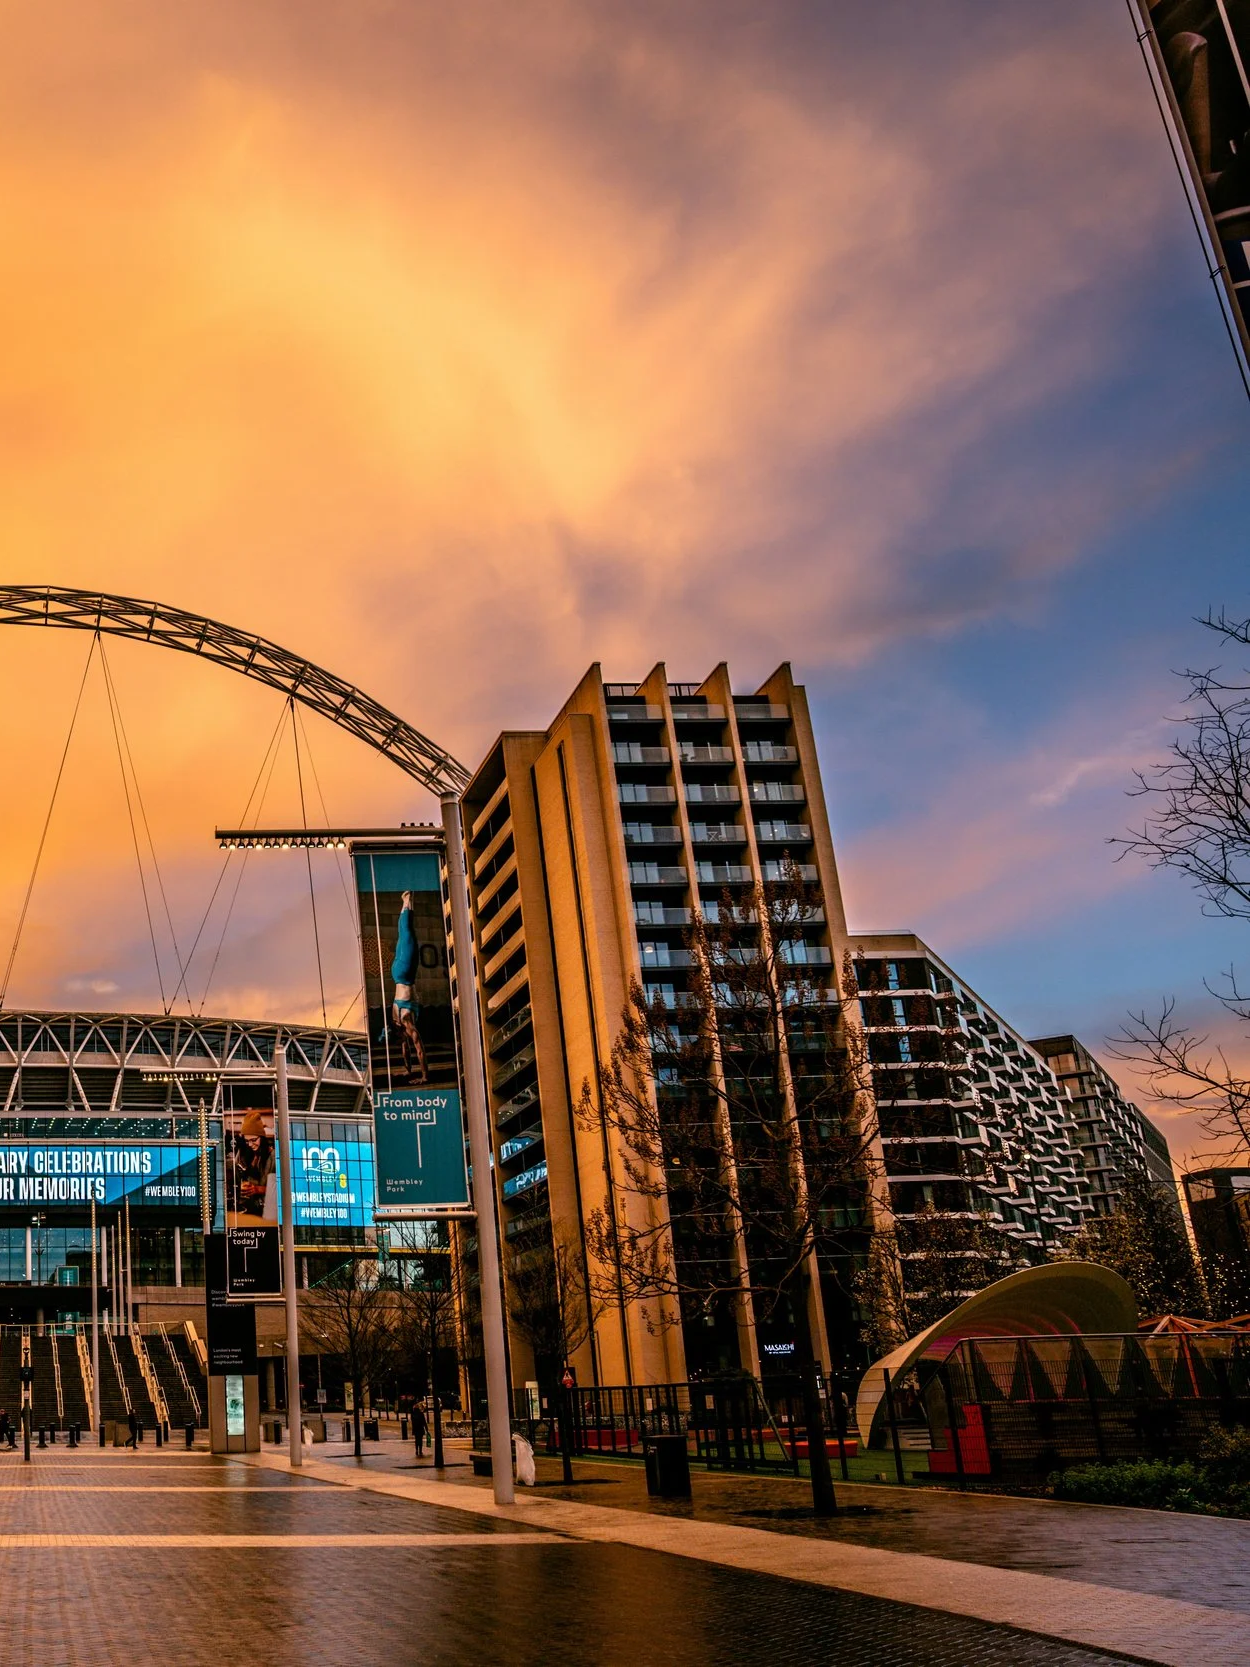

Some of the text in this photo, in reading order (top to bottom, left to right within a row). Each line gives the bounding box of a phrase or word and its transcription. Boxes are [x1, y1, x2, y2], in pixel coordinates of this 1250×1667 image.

[382, 1096, 447, 1109] From body
[384, 1109, 431, 1120] to mind
[33, 1150, 152, 1174] CELEBRATIONS
[301, 1147, 340, 1172] 100
[18, 1177, 106, 1201] MEMORIES
[145, 1185, 196, 1197] #WEMBLEY100
[300, 1207, 348, 1219] #WEMBLEY100
[232, 1229, 266, 1238] Swing by
[232, 1238, 255, 1246] today
